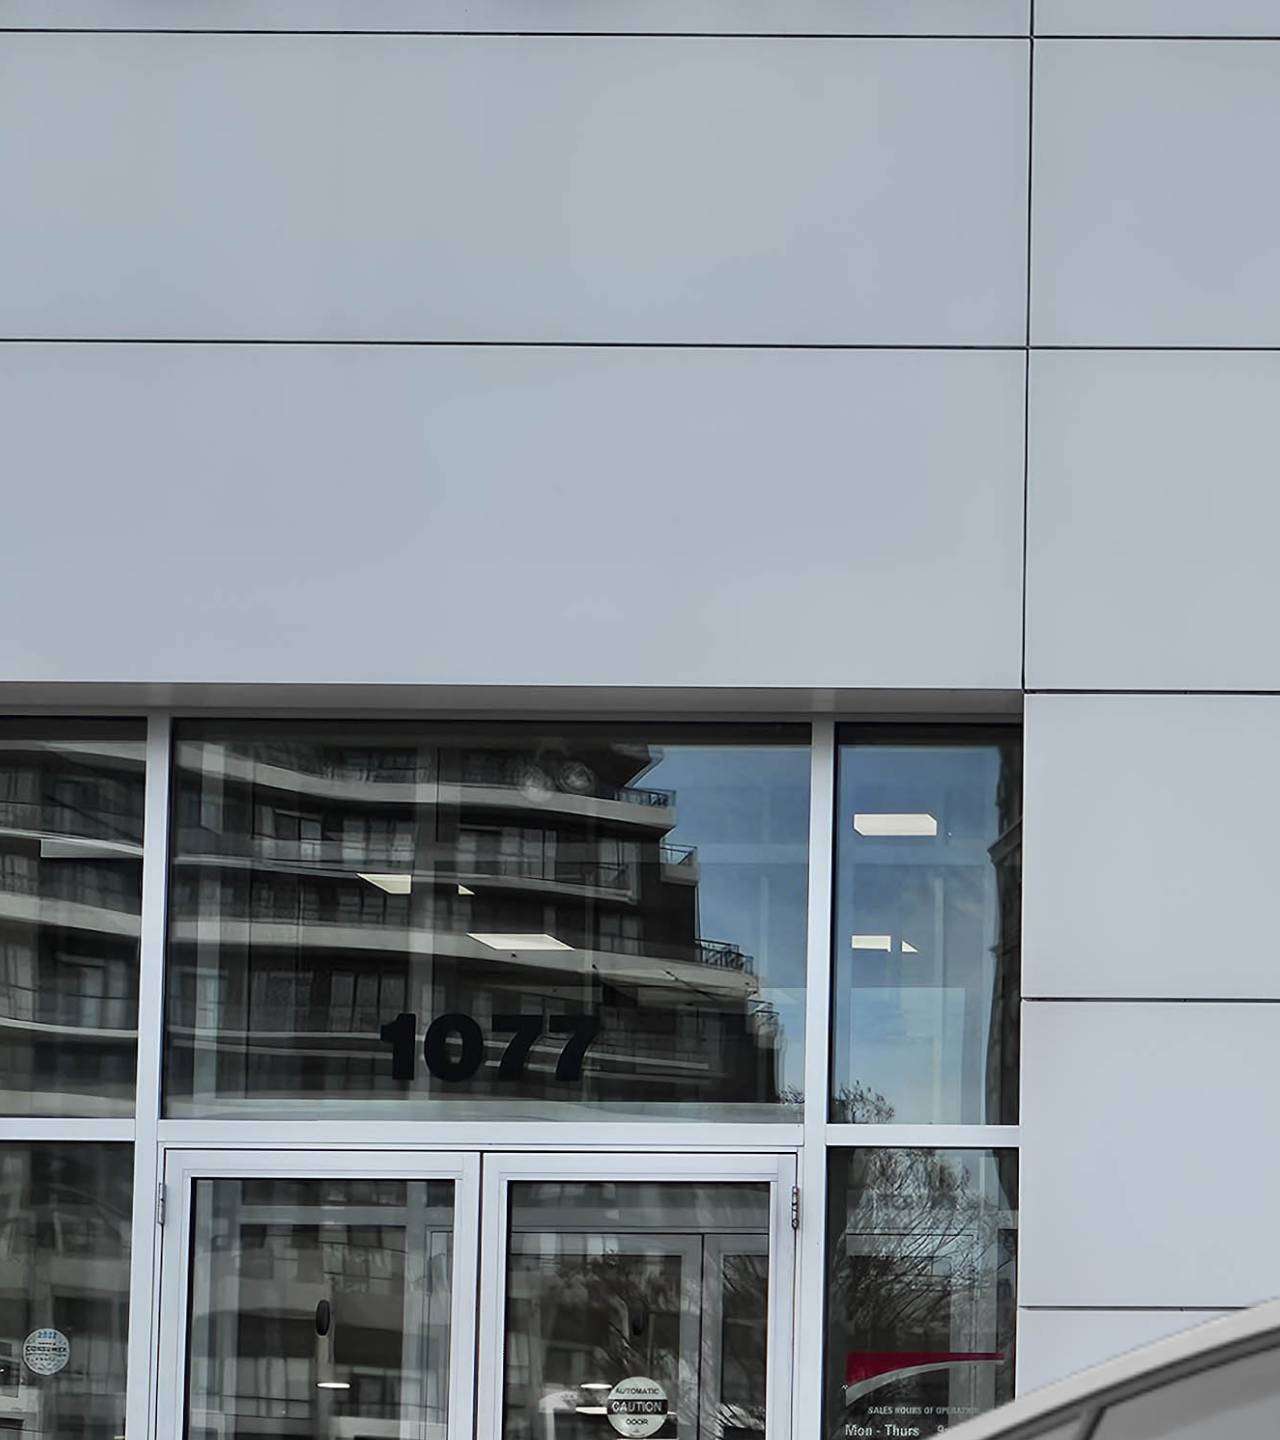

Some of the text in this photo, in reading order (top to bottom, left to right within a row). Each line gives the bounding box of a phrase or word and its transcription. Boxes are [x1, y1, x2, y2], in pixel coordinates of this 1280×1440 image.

[380, 1012, 601, 1083] 1077
[616, 1387, 660, 1395] AUTOMATIC
[611, 1401, 662, 1413] CAUTION
[867, 1406, 893, 1415] SALES
[625, 1418, 649, 1426] DOOR
[845, 1424, 873, 1437] Mon
[885, 1424, 920, 1437] Thurs
